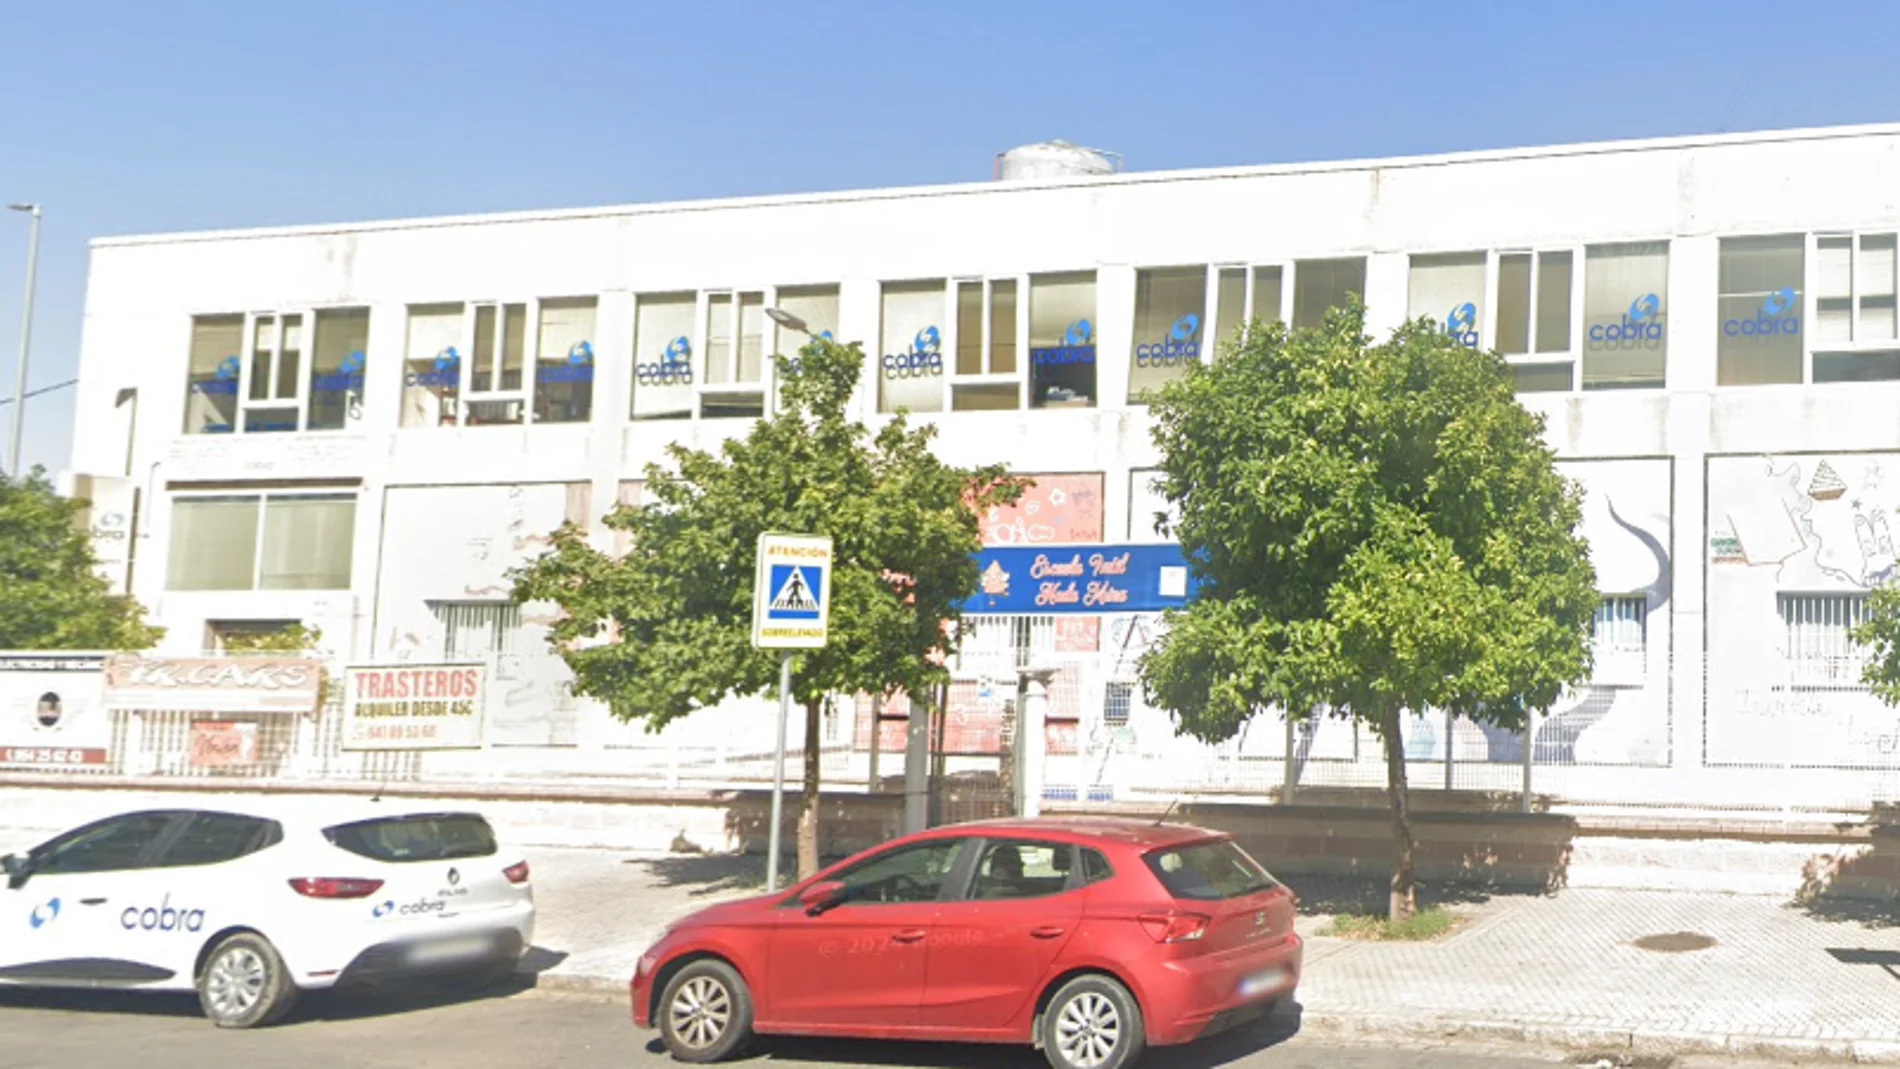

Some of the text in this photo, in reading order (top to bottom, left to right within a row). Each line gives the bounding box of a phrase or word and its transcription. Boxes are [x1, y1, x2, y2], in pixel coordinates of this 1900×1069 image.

[1589, 314, 1662, 342] cobra
[1724, 308, 1799, 336] cobra
[882, 344, 942, 369] cobra
[1136, 334, 1199, 359] cobra
[636, 355, 692, 377] cobra
[355, 670, 478, 698] TRASTEROS
[354, 701, 408, 717] ALQUILER
[412, 701, 448, 716] DESDE
[121, 891, 205, 932] cobra
[399, 897, 446, 916] cobra
